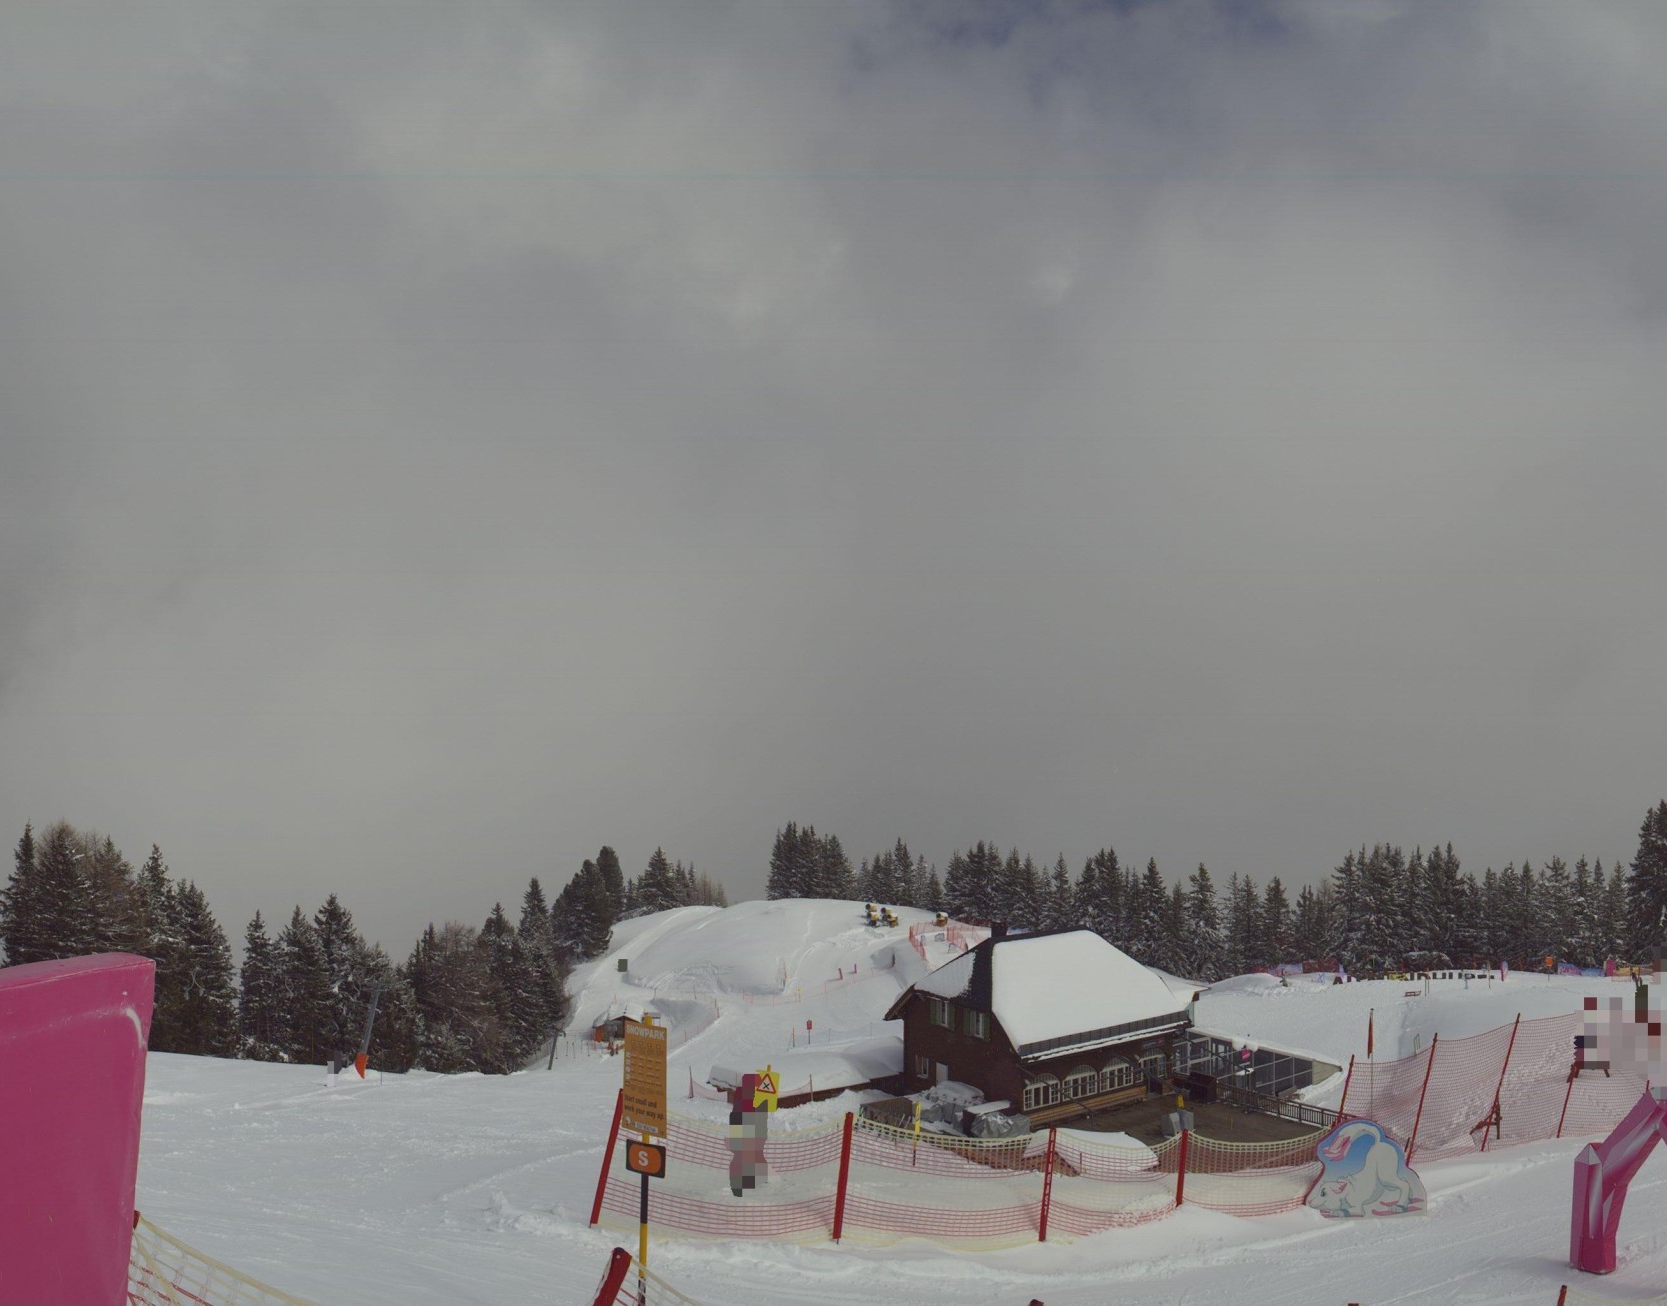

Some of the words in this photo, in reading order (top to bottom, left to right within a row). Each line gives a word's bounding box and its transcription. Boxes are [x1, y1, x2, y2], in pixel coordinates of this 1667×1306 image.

[626, 1024, 665, 1040] SNOWPARK
[635, 1097, 647, 1105] small
[648, 1100, 657, 1108] and
[624, 1104, 634, 1112] work
[646, 1110, 656, 1119] way
[638, 1150, 649, 1166] S
